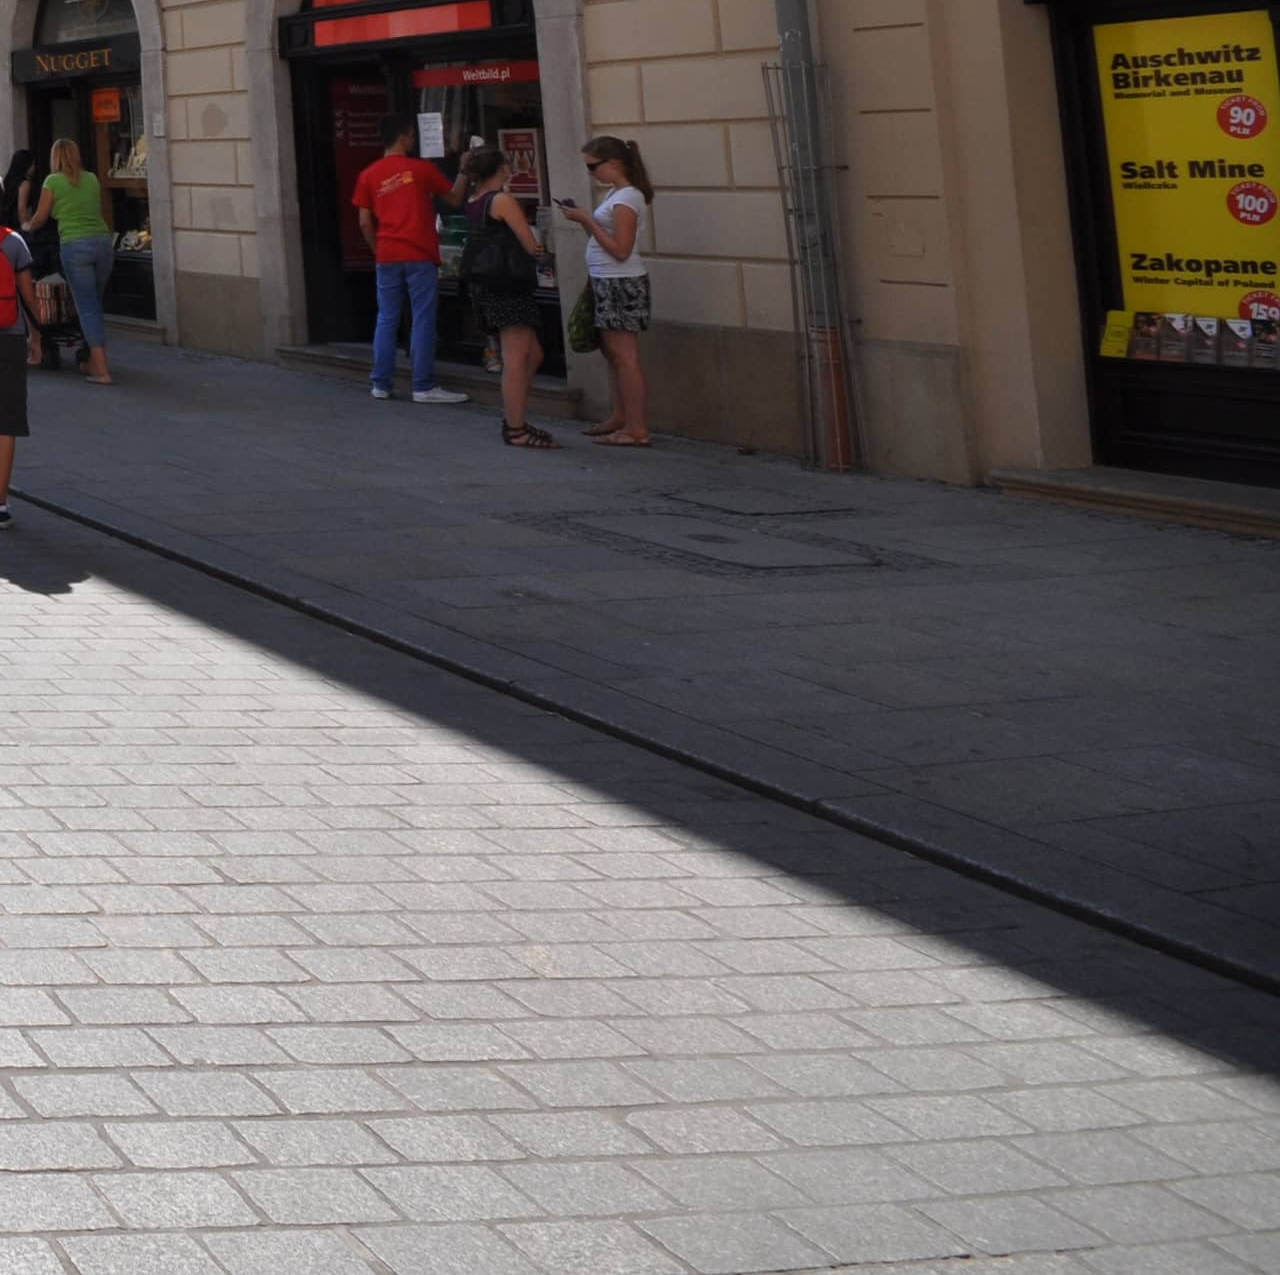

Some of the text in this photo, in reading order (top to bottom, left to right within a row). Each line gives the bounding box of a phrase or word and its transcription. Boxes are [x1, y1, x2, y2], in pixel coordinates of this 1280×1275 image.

[35, 48, 112, 72] NUGGET
[1111, 45, 1261, 70] Auschwitz
[462, 67, 511, 81] Weltbild.pl
[1112, 69, 1244, 90] Birkenau
[1114, 86, 1243, 100] Memorial and Museum
[1230, 106, 1256, 126] 90
[1121, 159, 1265, 179] Salt Mine
[1121, 181, 1178, 190] Wieliczka
[1236, 193, 1269, 214] 100
[1130, 253, 1277, 277] Zakopane
[1132, 276, 1276, 289] Winter Capital of Poland
